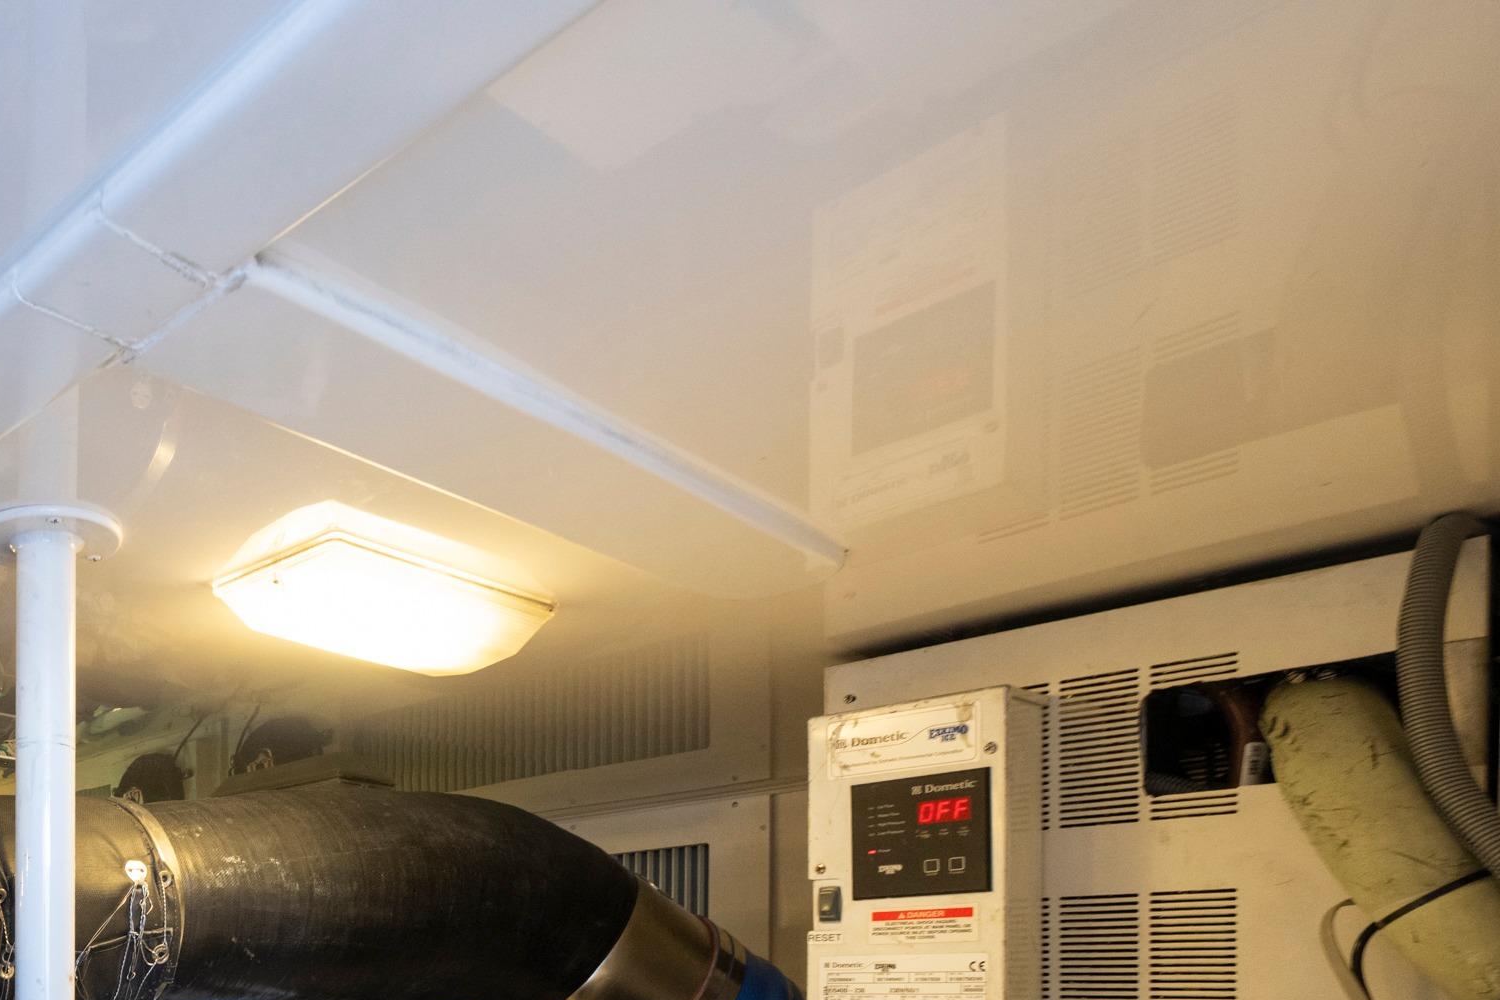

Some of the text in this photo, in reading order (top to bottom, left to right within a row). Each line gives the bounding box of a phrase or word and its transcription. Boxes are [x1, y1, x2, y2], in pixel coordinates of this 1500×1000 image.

[851, 730, 908, 748] Dometic
[925, 780, 975, 793] Dometic
[919, 798, 969, 823] OFF
[907, 910, 946, 919] DANGER
[808, 933, 842, 943] RESET
[969, 961, 986, 972] CE
